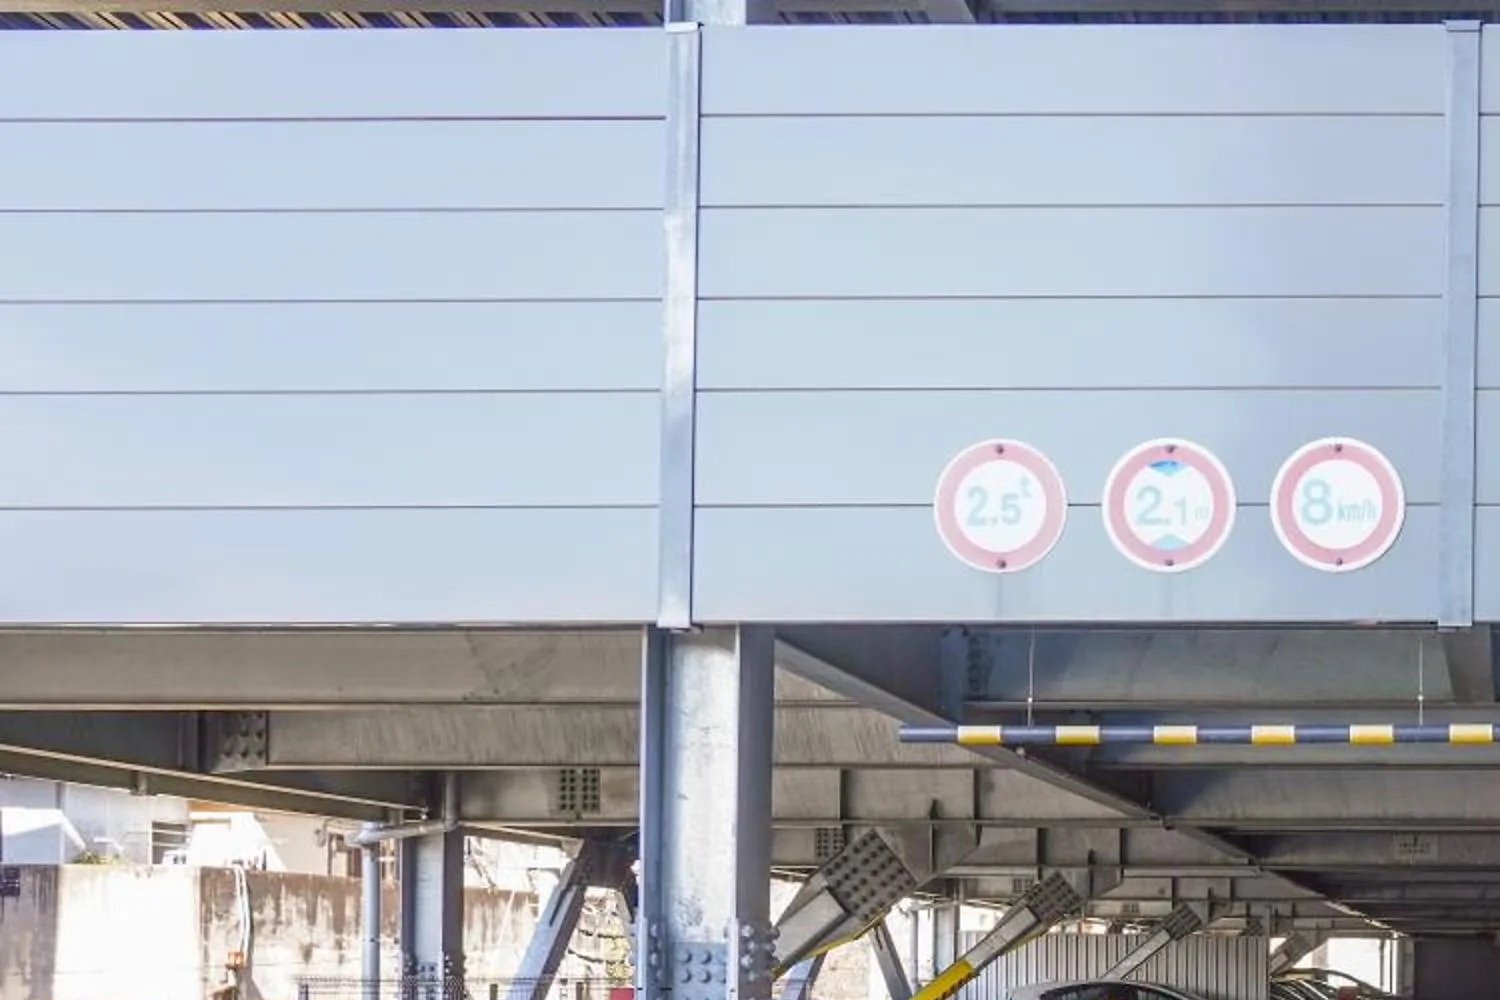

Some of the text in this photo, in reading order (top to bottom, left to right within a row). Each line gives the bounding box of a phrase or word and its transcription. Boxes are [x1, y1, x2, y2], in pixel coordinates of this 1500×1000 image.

[967, 485, 1022, 526] 2.5
[1136, 486, 1187, 526] 2.1
[1301, 478, 1377, 526] 8 km/h
